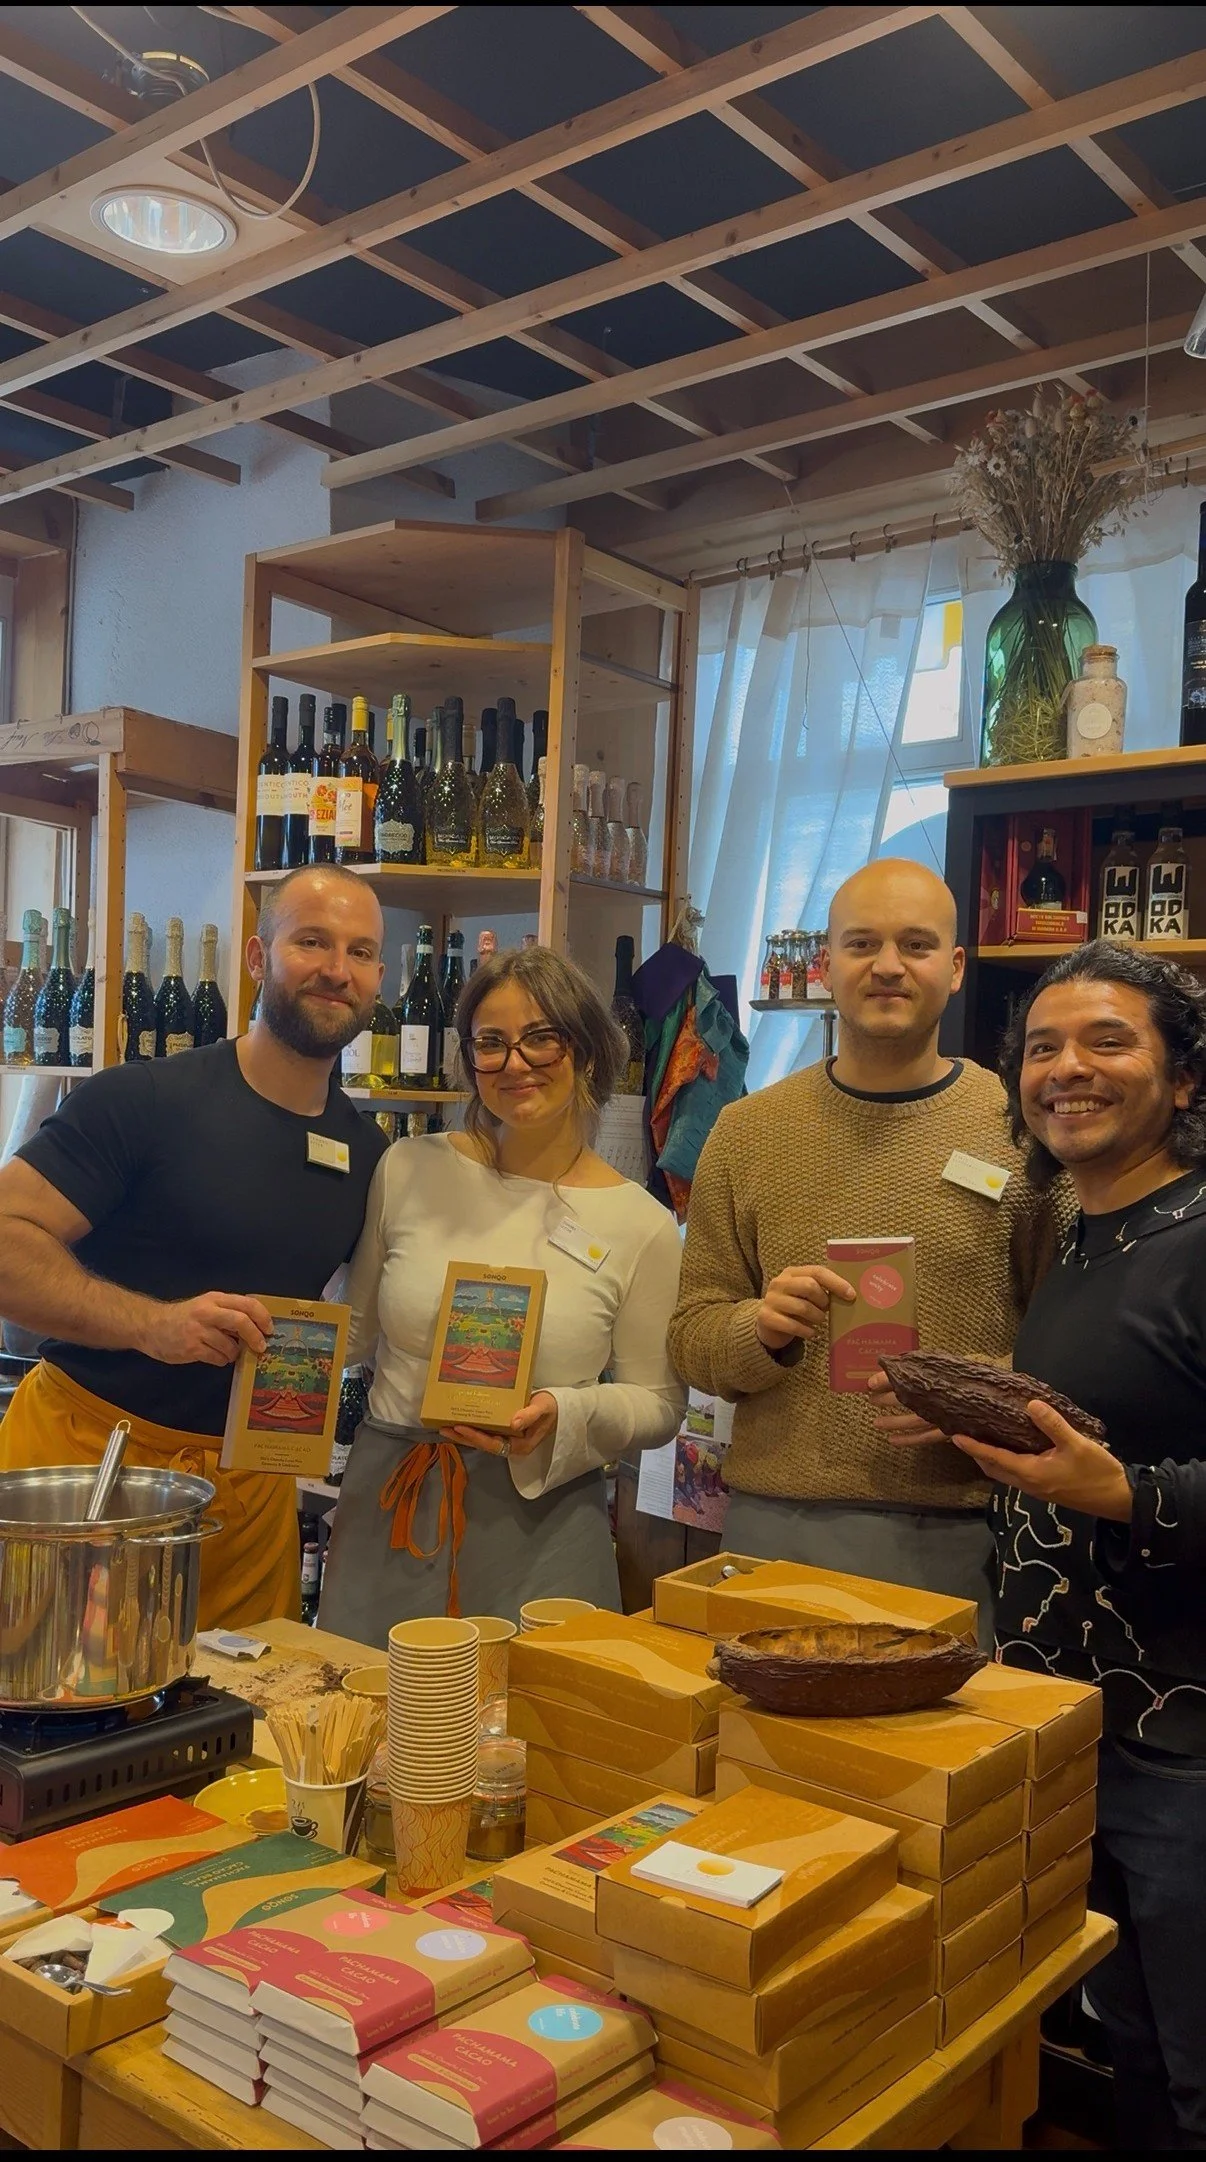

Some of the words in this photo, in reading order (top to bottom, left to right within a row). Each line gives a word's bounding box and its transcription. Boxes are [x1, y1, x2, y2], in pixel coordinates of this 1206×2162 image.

[1103, 919, 1135, 936] KA
[1149, 917, 1181, 934] KA
[483, 1273, 507, 1281] SONQO
[290, 1309, 314, 1318] SONQO
[261, 1893, 299, 1911] SONQO
[247, 1940, 279, 1954] CACAO
[248, 1930, 301, 1954] PACHAMAMA
[339, 1956, 401, 1985] PACHAMAMA
[340, 1966, 376, 1984] CACAO
[452, 2032, 518, 2068] PACHAMAMA
[454, 2045, 493, 2066] CACAO
